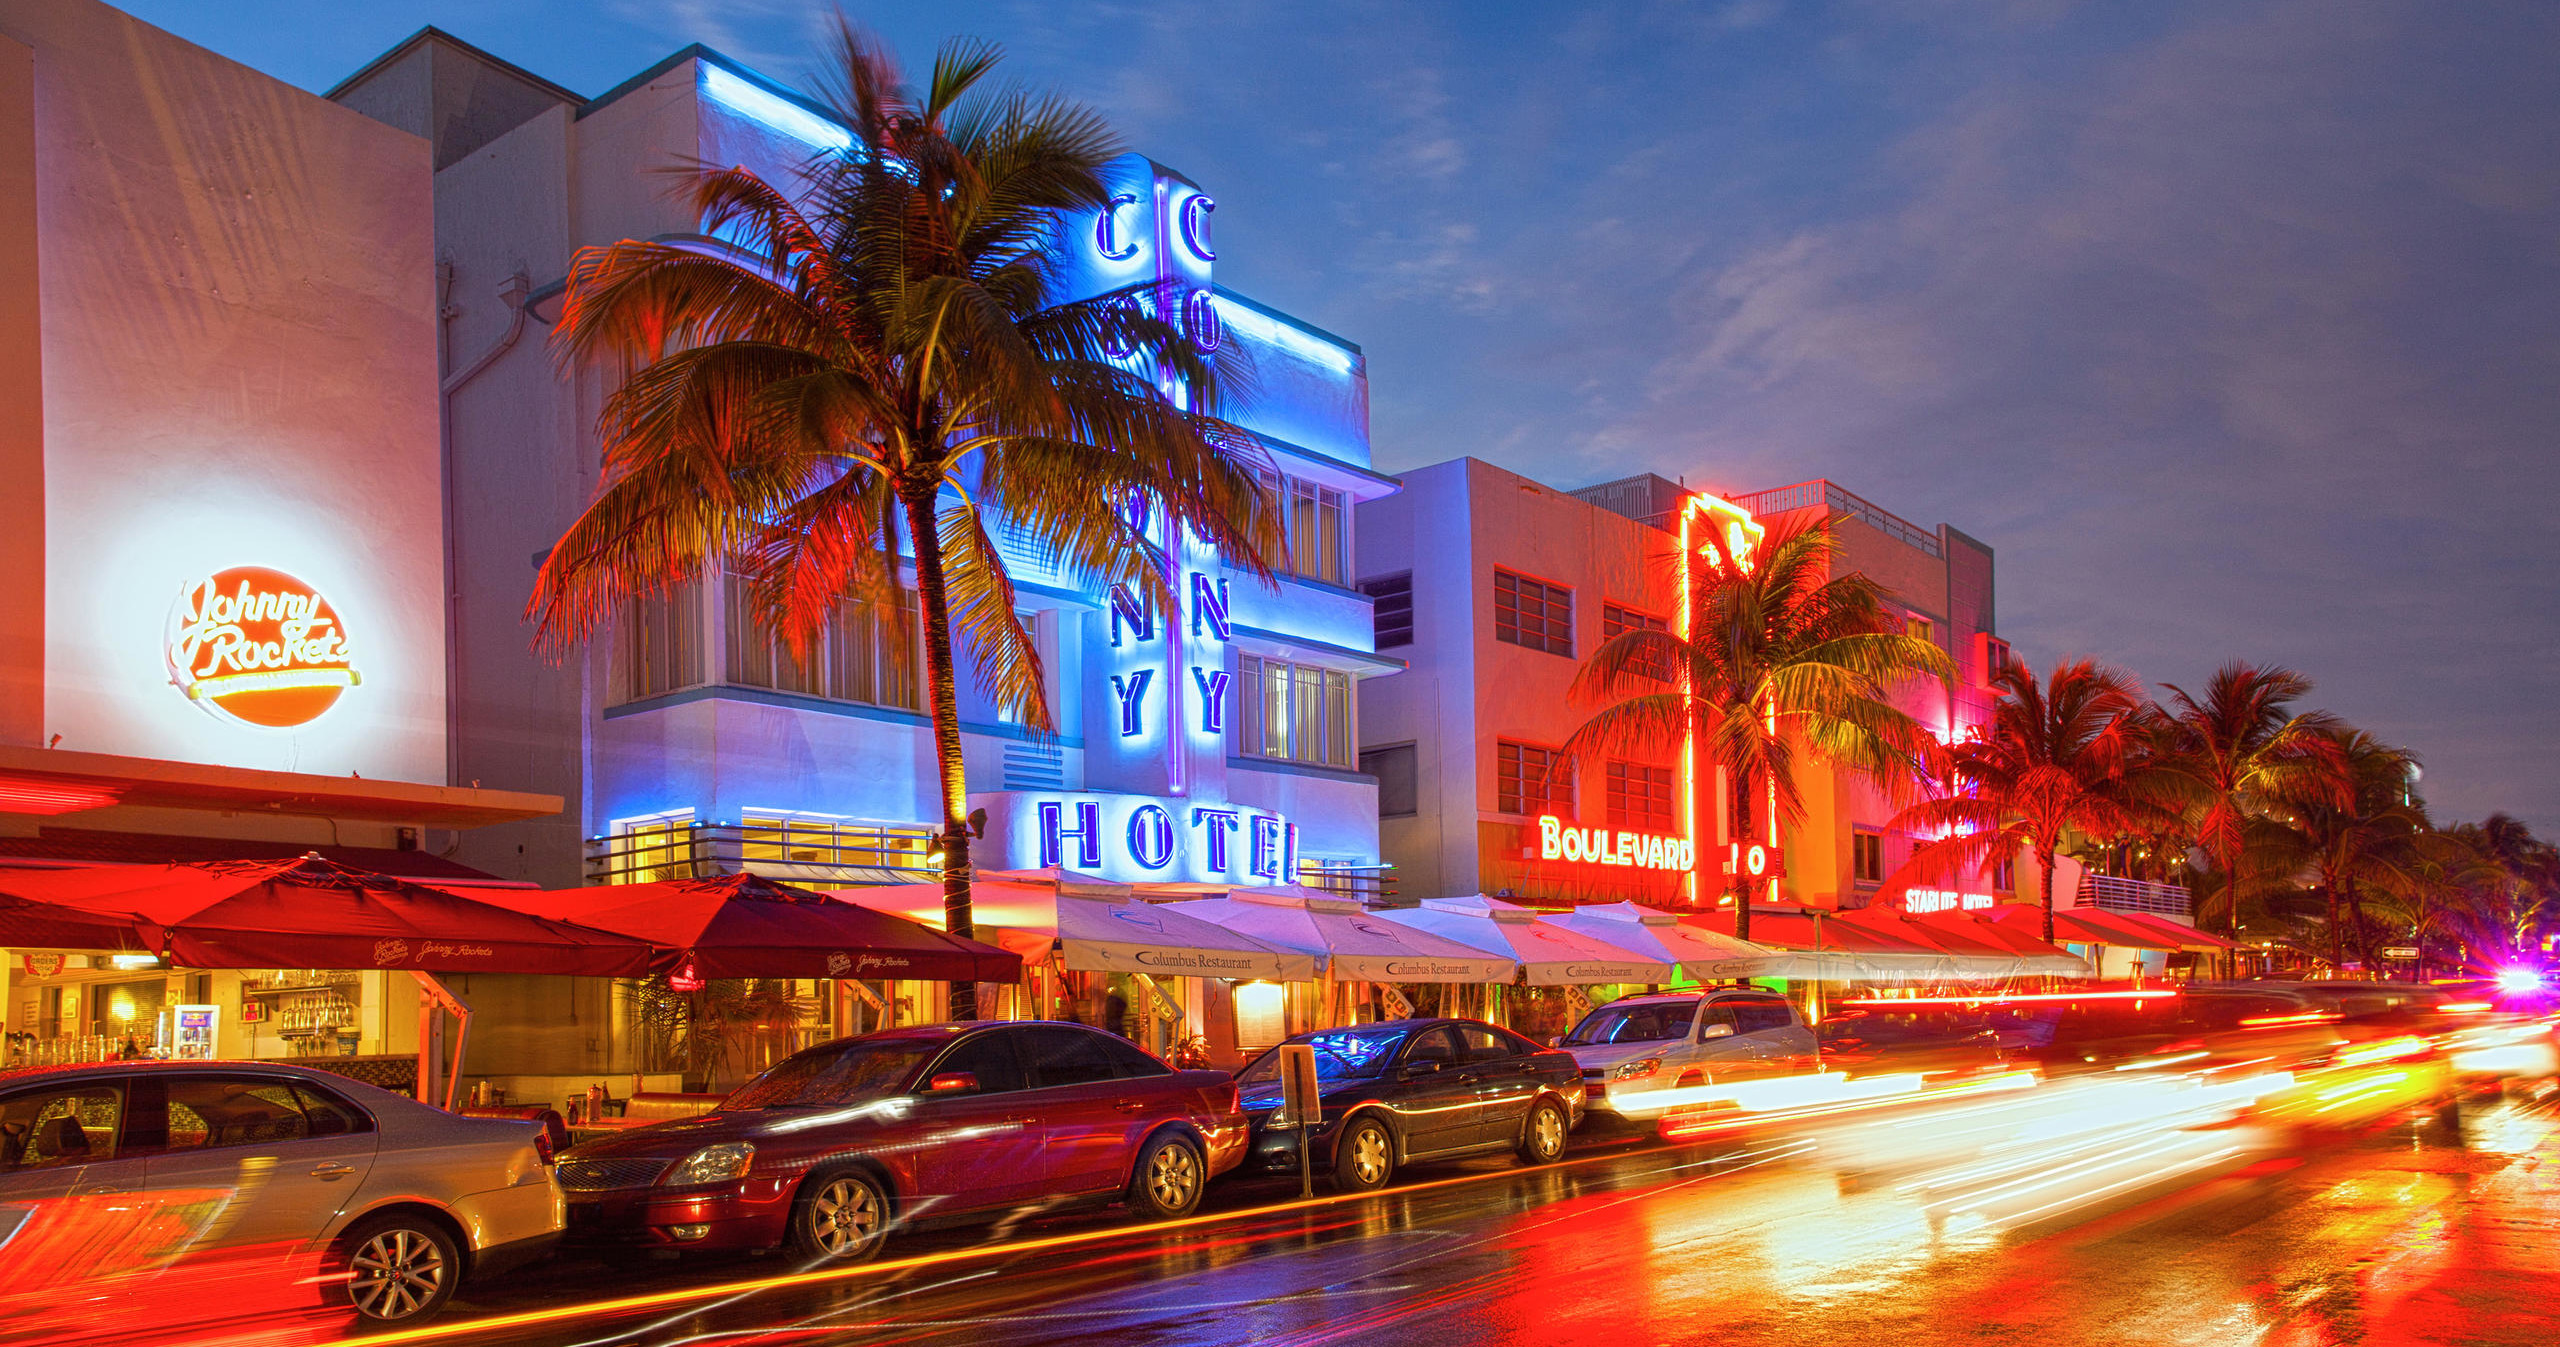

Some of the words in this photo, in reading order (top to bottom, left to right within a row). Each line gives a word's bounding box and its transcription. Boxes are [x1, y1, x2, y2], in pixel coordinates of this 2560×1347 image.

[174, 578, 332, 668] Johnny
[196, 627, 351, 677] Rockets
[1038, 800, 1301, 884] HOTEL
[1539, 815, 1696, 871] BOULEVARD
[1135, 951, 1197, 968] Columbus
[1198, 954, 1252, 969] Restaurant
[1386, 962, 1430, 975] Columbus
[1431, 963, 1470, 975] Restaurant
[1566, 965, 1600, 977] Columbus
[1600, 966, 1633, 977] Restaurant
